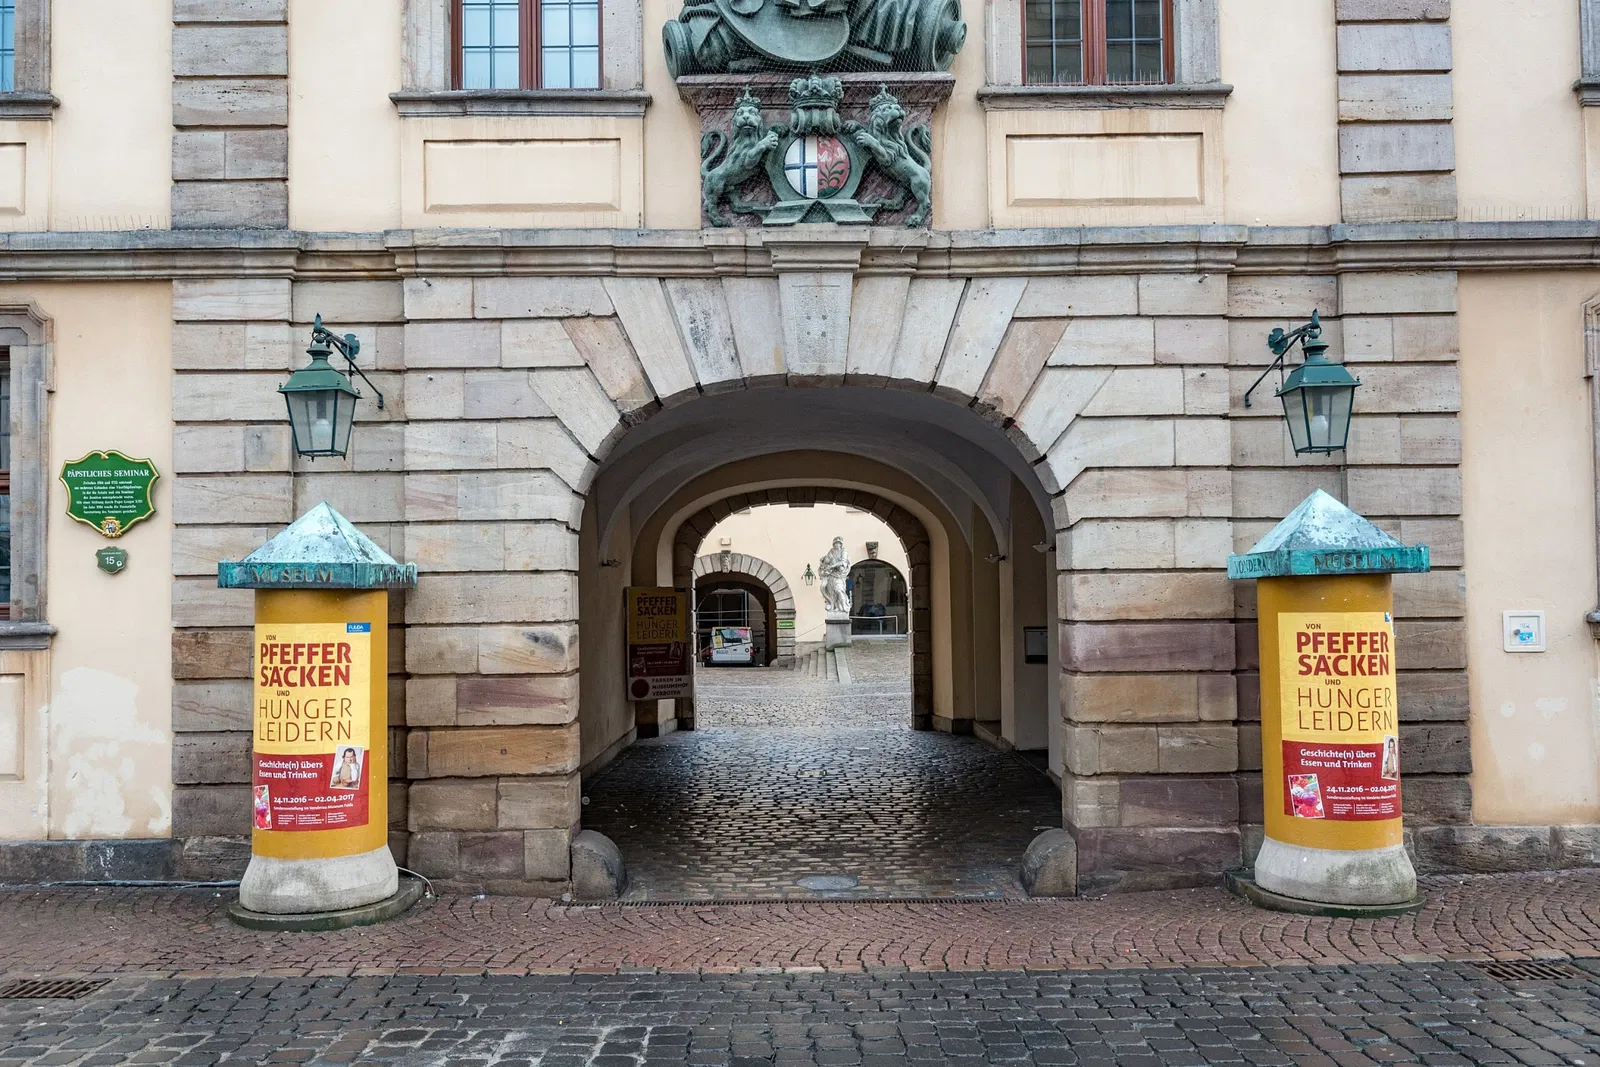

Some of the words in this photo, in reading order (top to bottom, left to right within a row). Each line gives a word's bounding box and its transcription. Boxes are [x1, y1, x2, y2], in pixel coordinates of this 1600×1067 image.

[1312, 554, 1396, 569] MUSEUM
[252, 568, 334, 582] MUSEUM
[637, 596, 677, 606] PFEFFER
[637, 620, 678, 629] HUNGER
[637, 630, 678, 639] LEIDERN
[1296, 631, 1389, 653] PFEFFER
[260, 643, 352, 664] PFEFFER
[1298, 654, 1389, 676] SÄCKEN
[260, 665, 350, 687] SÄCKEN
[1298, 687, 1392, 708] HUNGER
[260, 698, 352, 719] HUNGER
[1299, 710, 1392, 731] LEIDERN
[260, 720, 351, 742] LEIDERN
[1300, 749, 1354, 760] Geschichte(n)
[259, 760, 299, 770] Geschichte(n)
[1326, 785, 1363, 793] 24.11.2016
[274, 796, 307, 804] 24.11.2016
[315, 794, 354, 802] 02.04.2017
